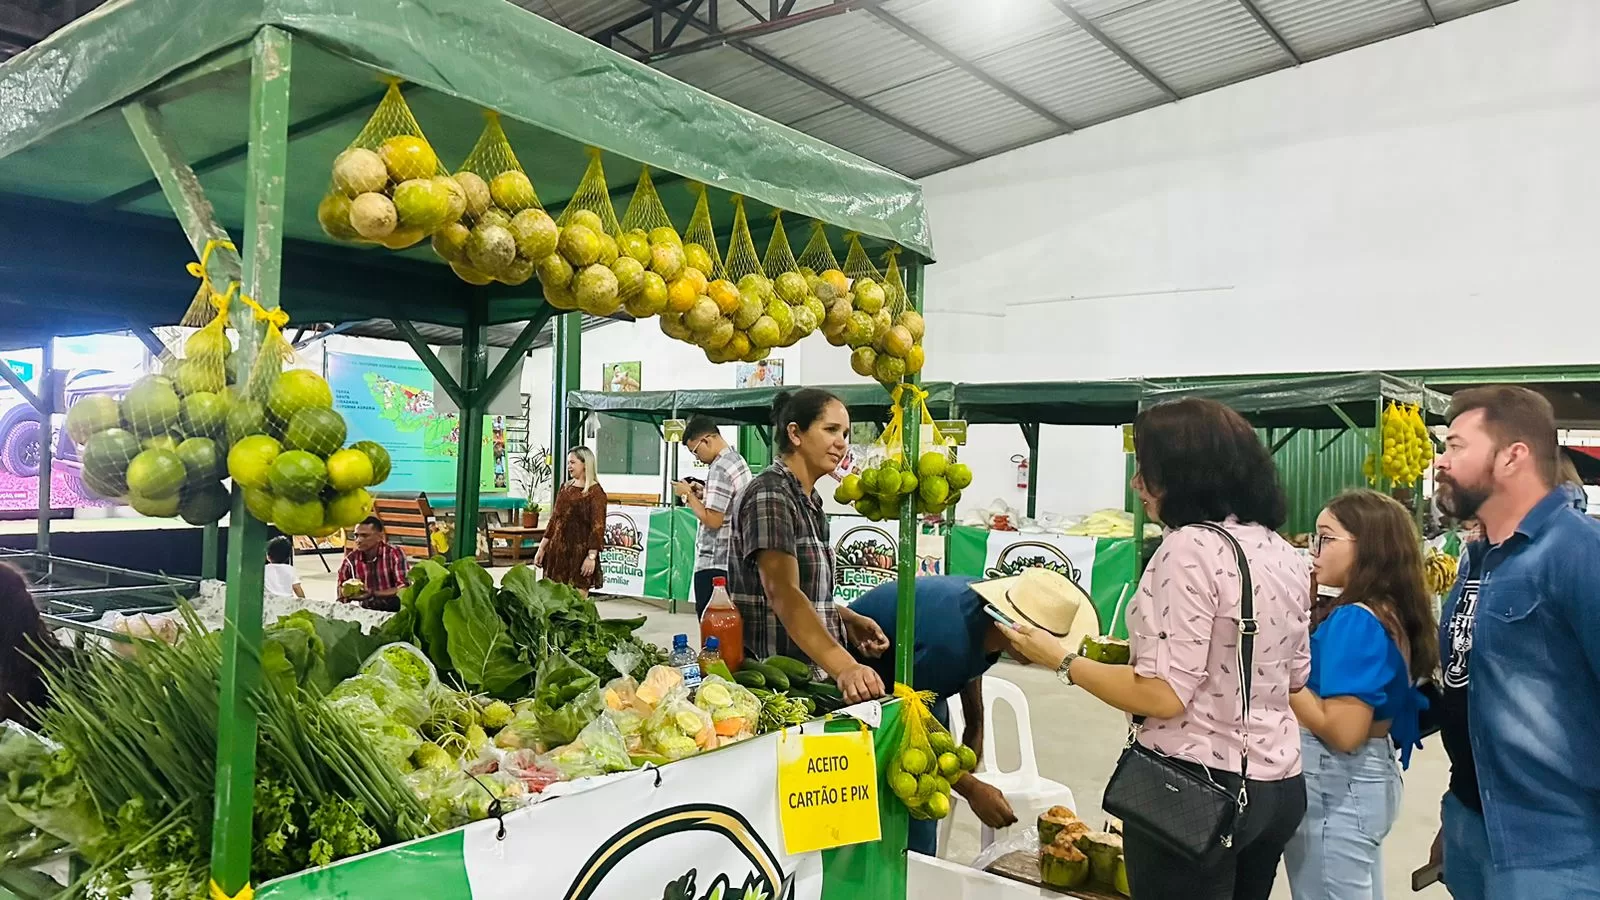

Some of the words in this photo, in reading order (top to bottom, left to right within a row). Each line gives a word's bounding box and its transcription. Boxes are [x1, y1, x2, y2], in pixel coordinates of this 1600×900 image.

[600, 551, 624, 561] Feira
[845, 569, 878, 584] Feira
[833, 585, 867, 601] Agric
[807, 755, 849, 774] ACEITO
[788, 785, 838, 809] CARTÃO
[841, 787, 848, 802] E
[851, 784, 869, 801] PIX
